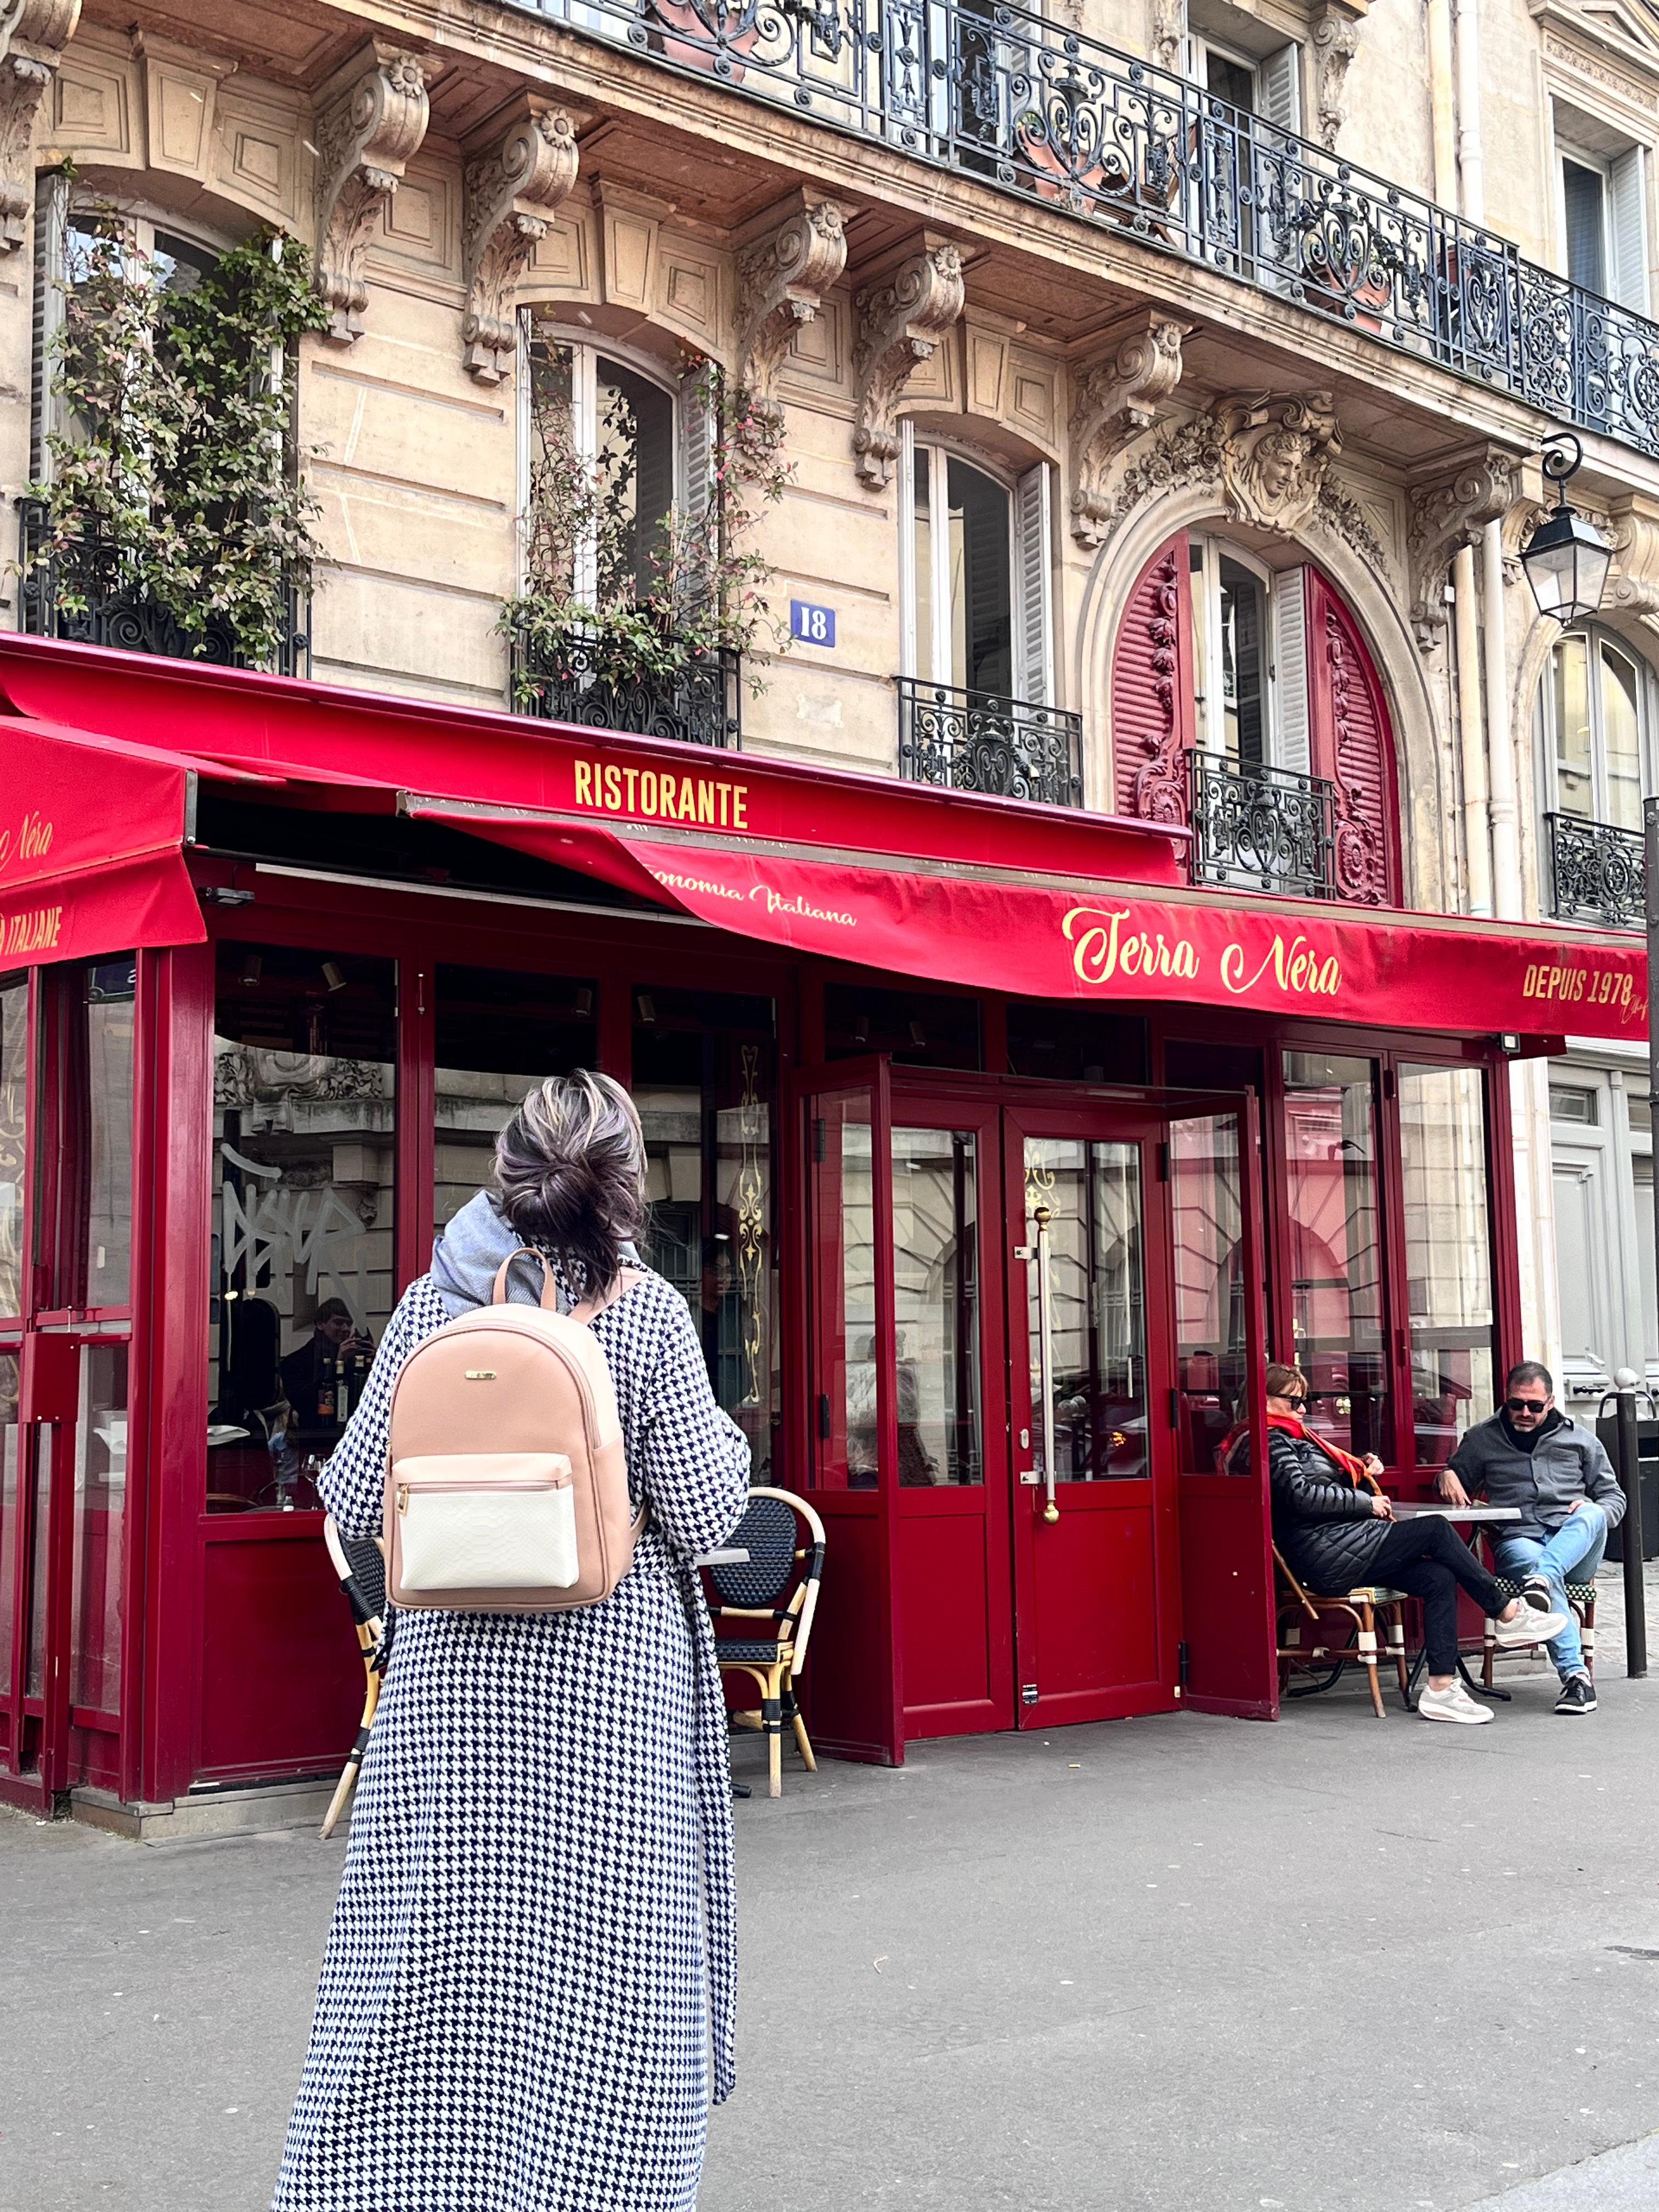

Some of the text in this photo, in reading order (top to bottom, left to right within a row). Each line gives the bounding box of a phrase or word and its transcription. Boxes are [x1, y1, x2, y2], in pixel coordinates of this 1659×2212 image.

[800, 606, 827, 640] 18
[574, 760, 748, 829] RISTORANTE
[0, 810, 53, 872] Nera
[642, 864, 857, 926] onomia Italiana
[4, 906, 63, 956] ITALIANE
[1062, 907, 1342, 996] Terra Nera
[1522, 964, 1634, 1006] DEPUIS 1978
